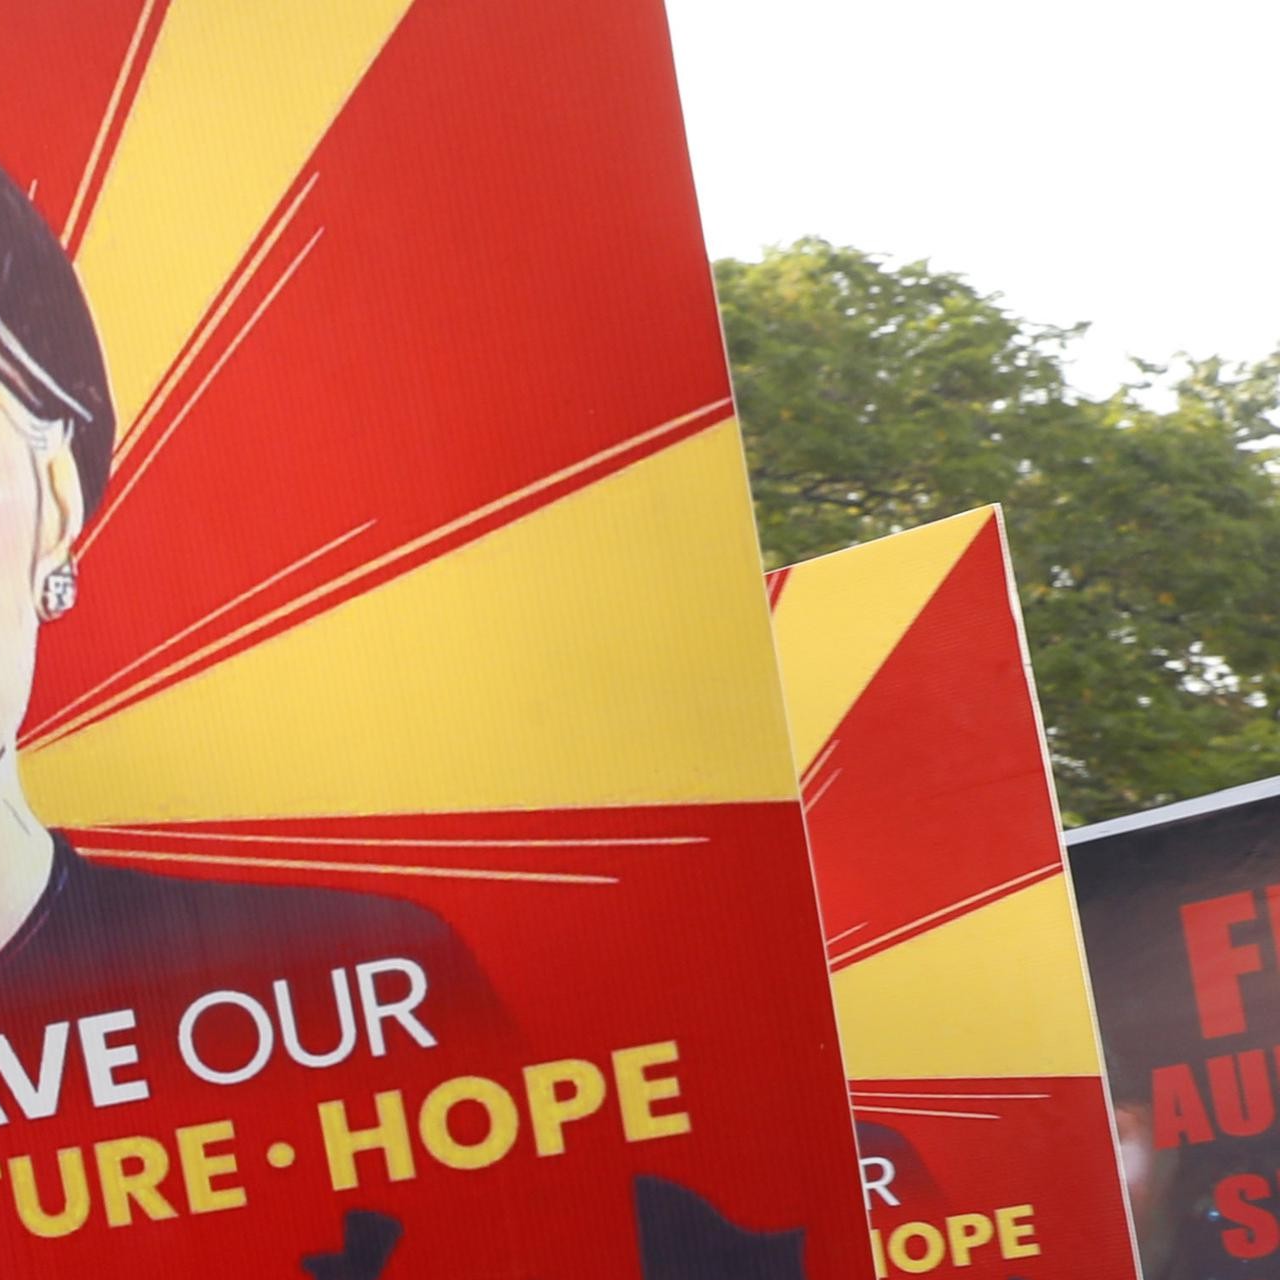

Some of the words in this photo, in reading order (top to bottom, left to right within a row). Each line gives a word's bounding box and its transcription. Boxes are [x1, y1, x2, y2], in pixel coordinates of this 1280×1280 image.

[177, 957, 438, 1085] OUR
[317, 1040, 692, 1191] HOPE
[1151, 1044, 1280, 1148] AU
